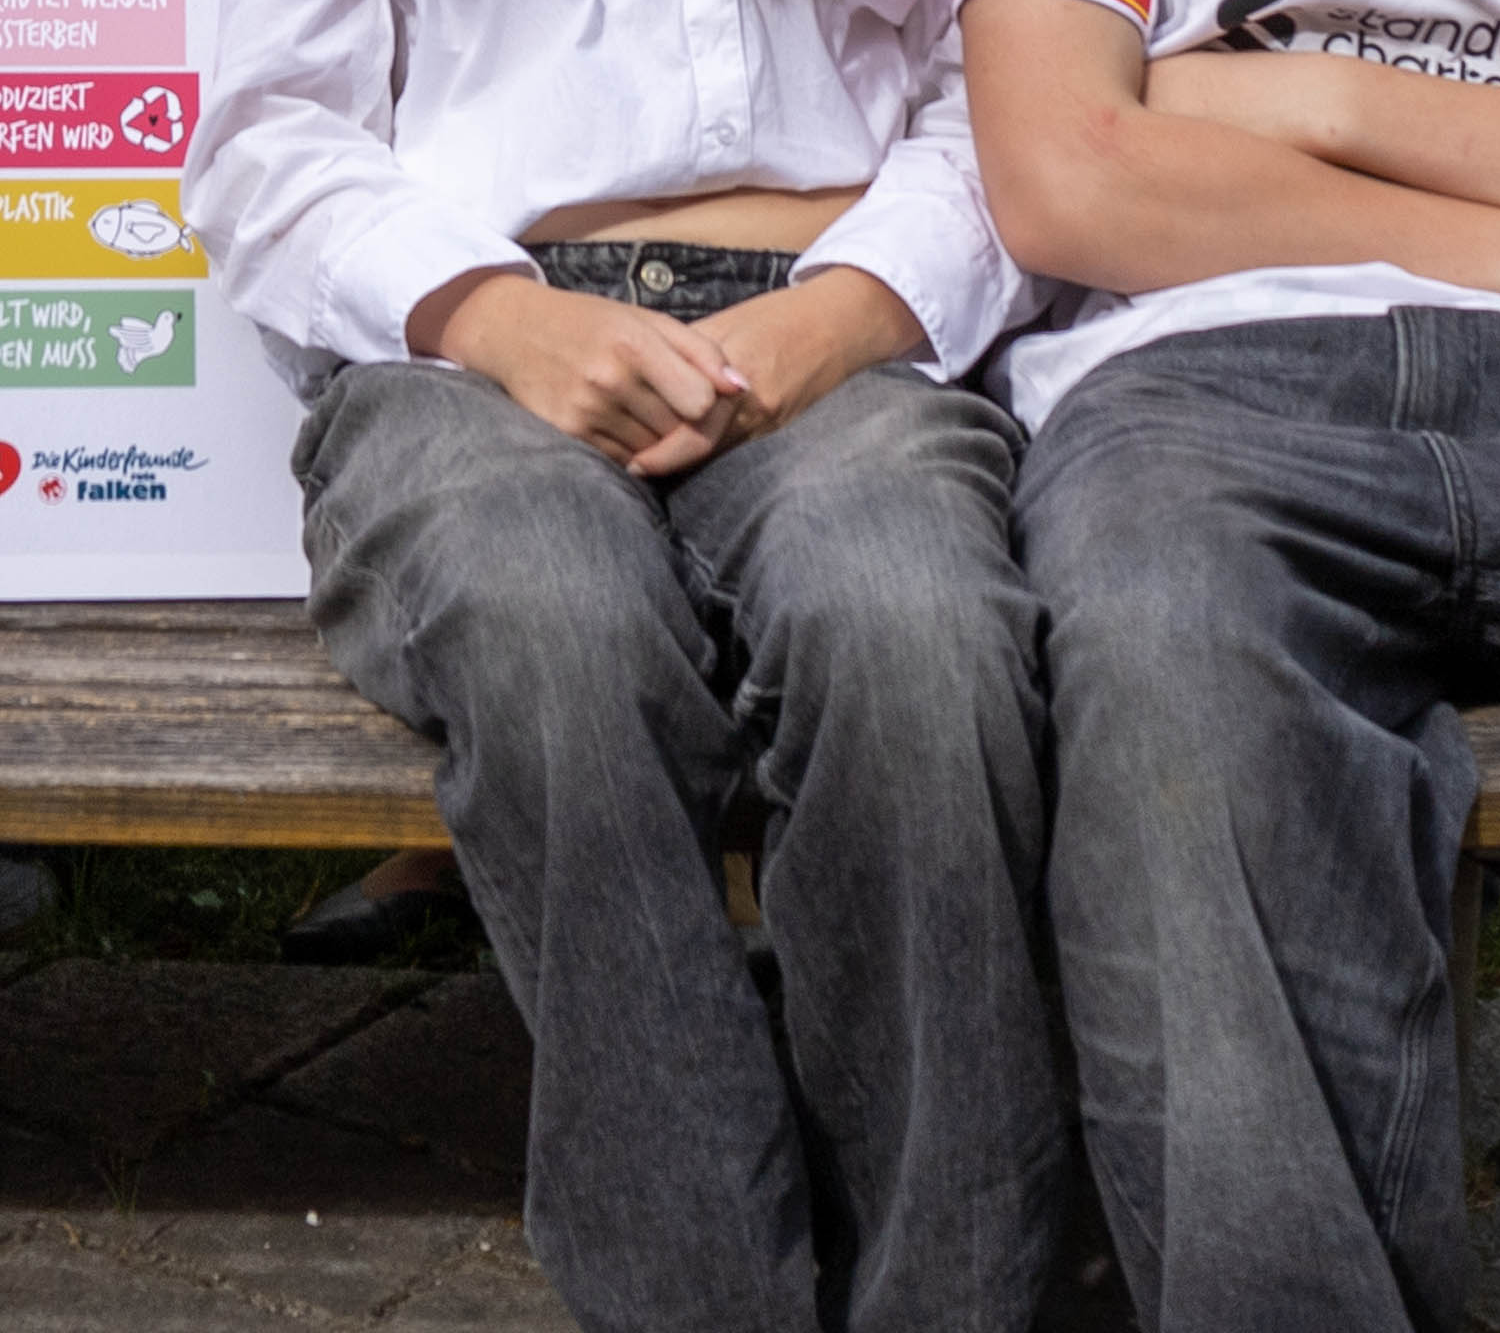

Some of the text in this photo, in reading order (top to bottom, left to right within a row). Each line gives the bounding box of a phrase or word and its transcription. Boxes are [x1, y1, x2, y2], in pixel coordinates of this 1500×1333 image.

[62, 122, 114, 150] WIRD
[31, 300, 92, 334] WIRD,
[40, 337, 97, 369] MUSS
[62, 443, 210, 475] Kinderfreunde
[76, 479, 168, 501] falken
